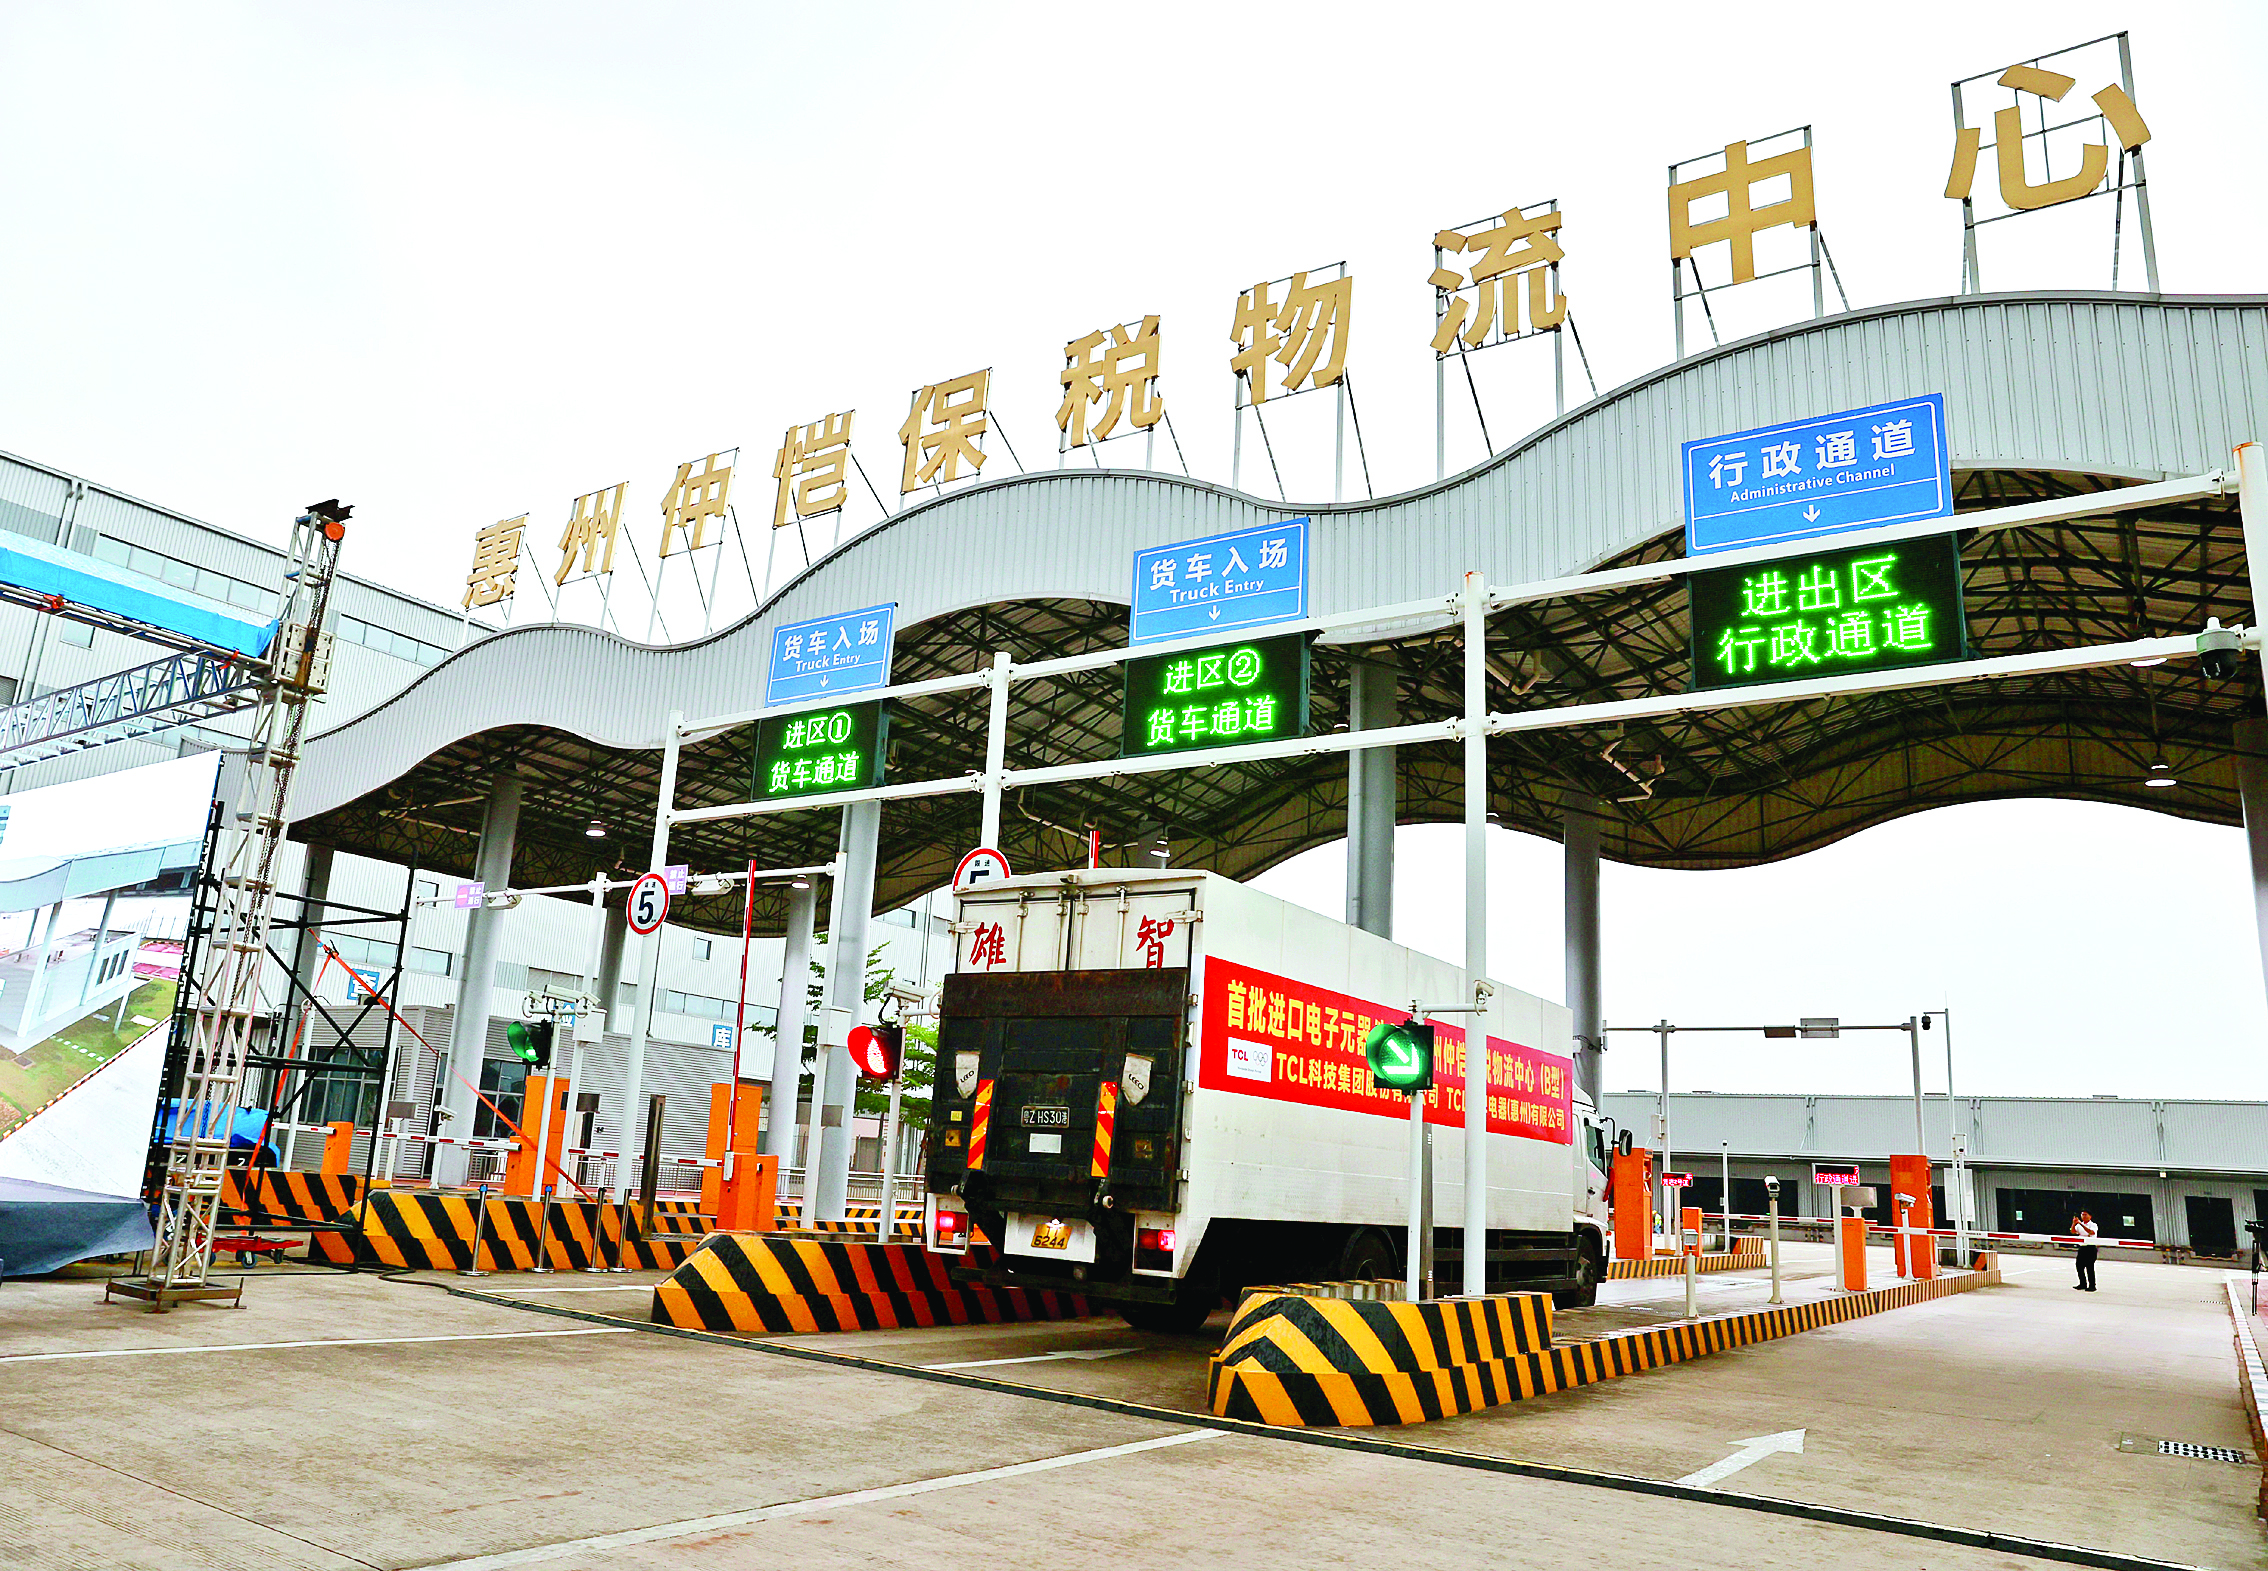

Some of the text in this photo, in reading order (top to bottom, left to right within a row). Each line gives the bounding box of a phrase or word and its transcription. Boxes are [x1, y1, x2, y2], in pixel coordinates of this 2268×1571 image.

[462, 65, 2151, 609] 惠州仲恺保税物流中心
[1709, 420, 1915, 490] 行政通道
[1730, 462, 1896, 503] Administrative Channel
[1150, 538, 1288, 591] 货车入场
[1170, 576, 1264, 602] Truck Entry
[1742, 554, 1899, 617] 进出区
[784, 620, 879, 660] 货车入场
[1716, 602, 1932, 676] 行政通道
[795, 653, 861, 672] Truck Entry
[1146, 696, 1277, 746] 货车通道
[769, 751, 859, 793] 货车通道
[637, 890, 655, 925] 5
[1232, 1048, 1249, 1061] TCL
[1033, 1234, 1066, 1248] 6244
